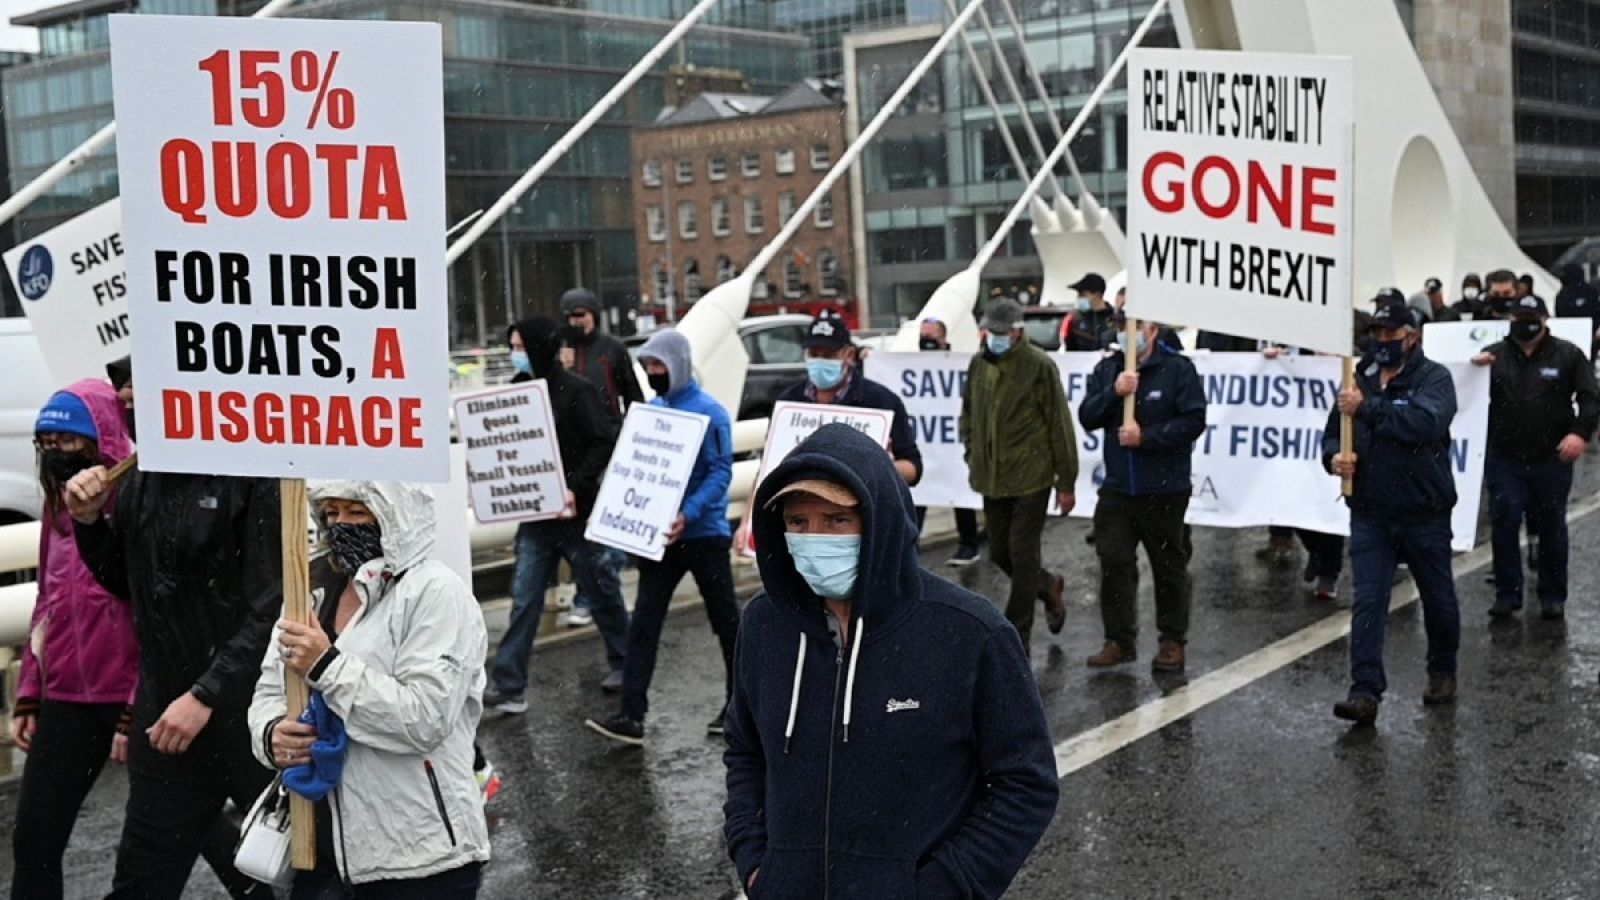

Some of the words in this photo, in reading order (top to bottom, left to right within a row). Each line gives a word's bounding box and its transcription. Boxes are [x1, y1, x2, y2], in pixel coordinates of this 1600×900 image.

[198, 48, 356, 130] 15%
[1143, 68, 1226, 136] RELATIVE
[1231, 72, 1327, 146] STABILITY
[159, 137, 408, 224] QUOTA
[1141, 150, 1337, 236] GONE
[70, 232, 125, 275] SAVE
[1140, 232, 1220, 287] WITH
[1229, 242, 1337, 306] BREXIT
[92, 270, 128, 306] FIS
[154, 249, 252, 305] FOR
[269, 254, 417, 310] IRISH
[174, 320, 356, 384] BOATS,
[371, 327, 405, 380] A
[161, 388, 424, 449] DISGRACE
[467, 395, 530, 415] Eliminate
[482, 414, 520, 432] Quota
[467, 428, 545, 450] Restrictions
[496, 449, 518, 462] For
[489, 481, 541, 497] Inshore
[623, 487, 651, 511] Our
[600, 506, 660, 546] Industry
